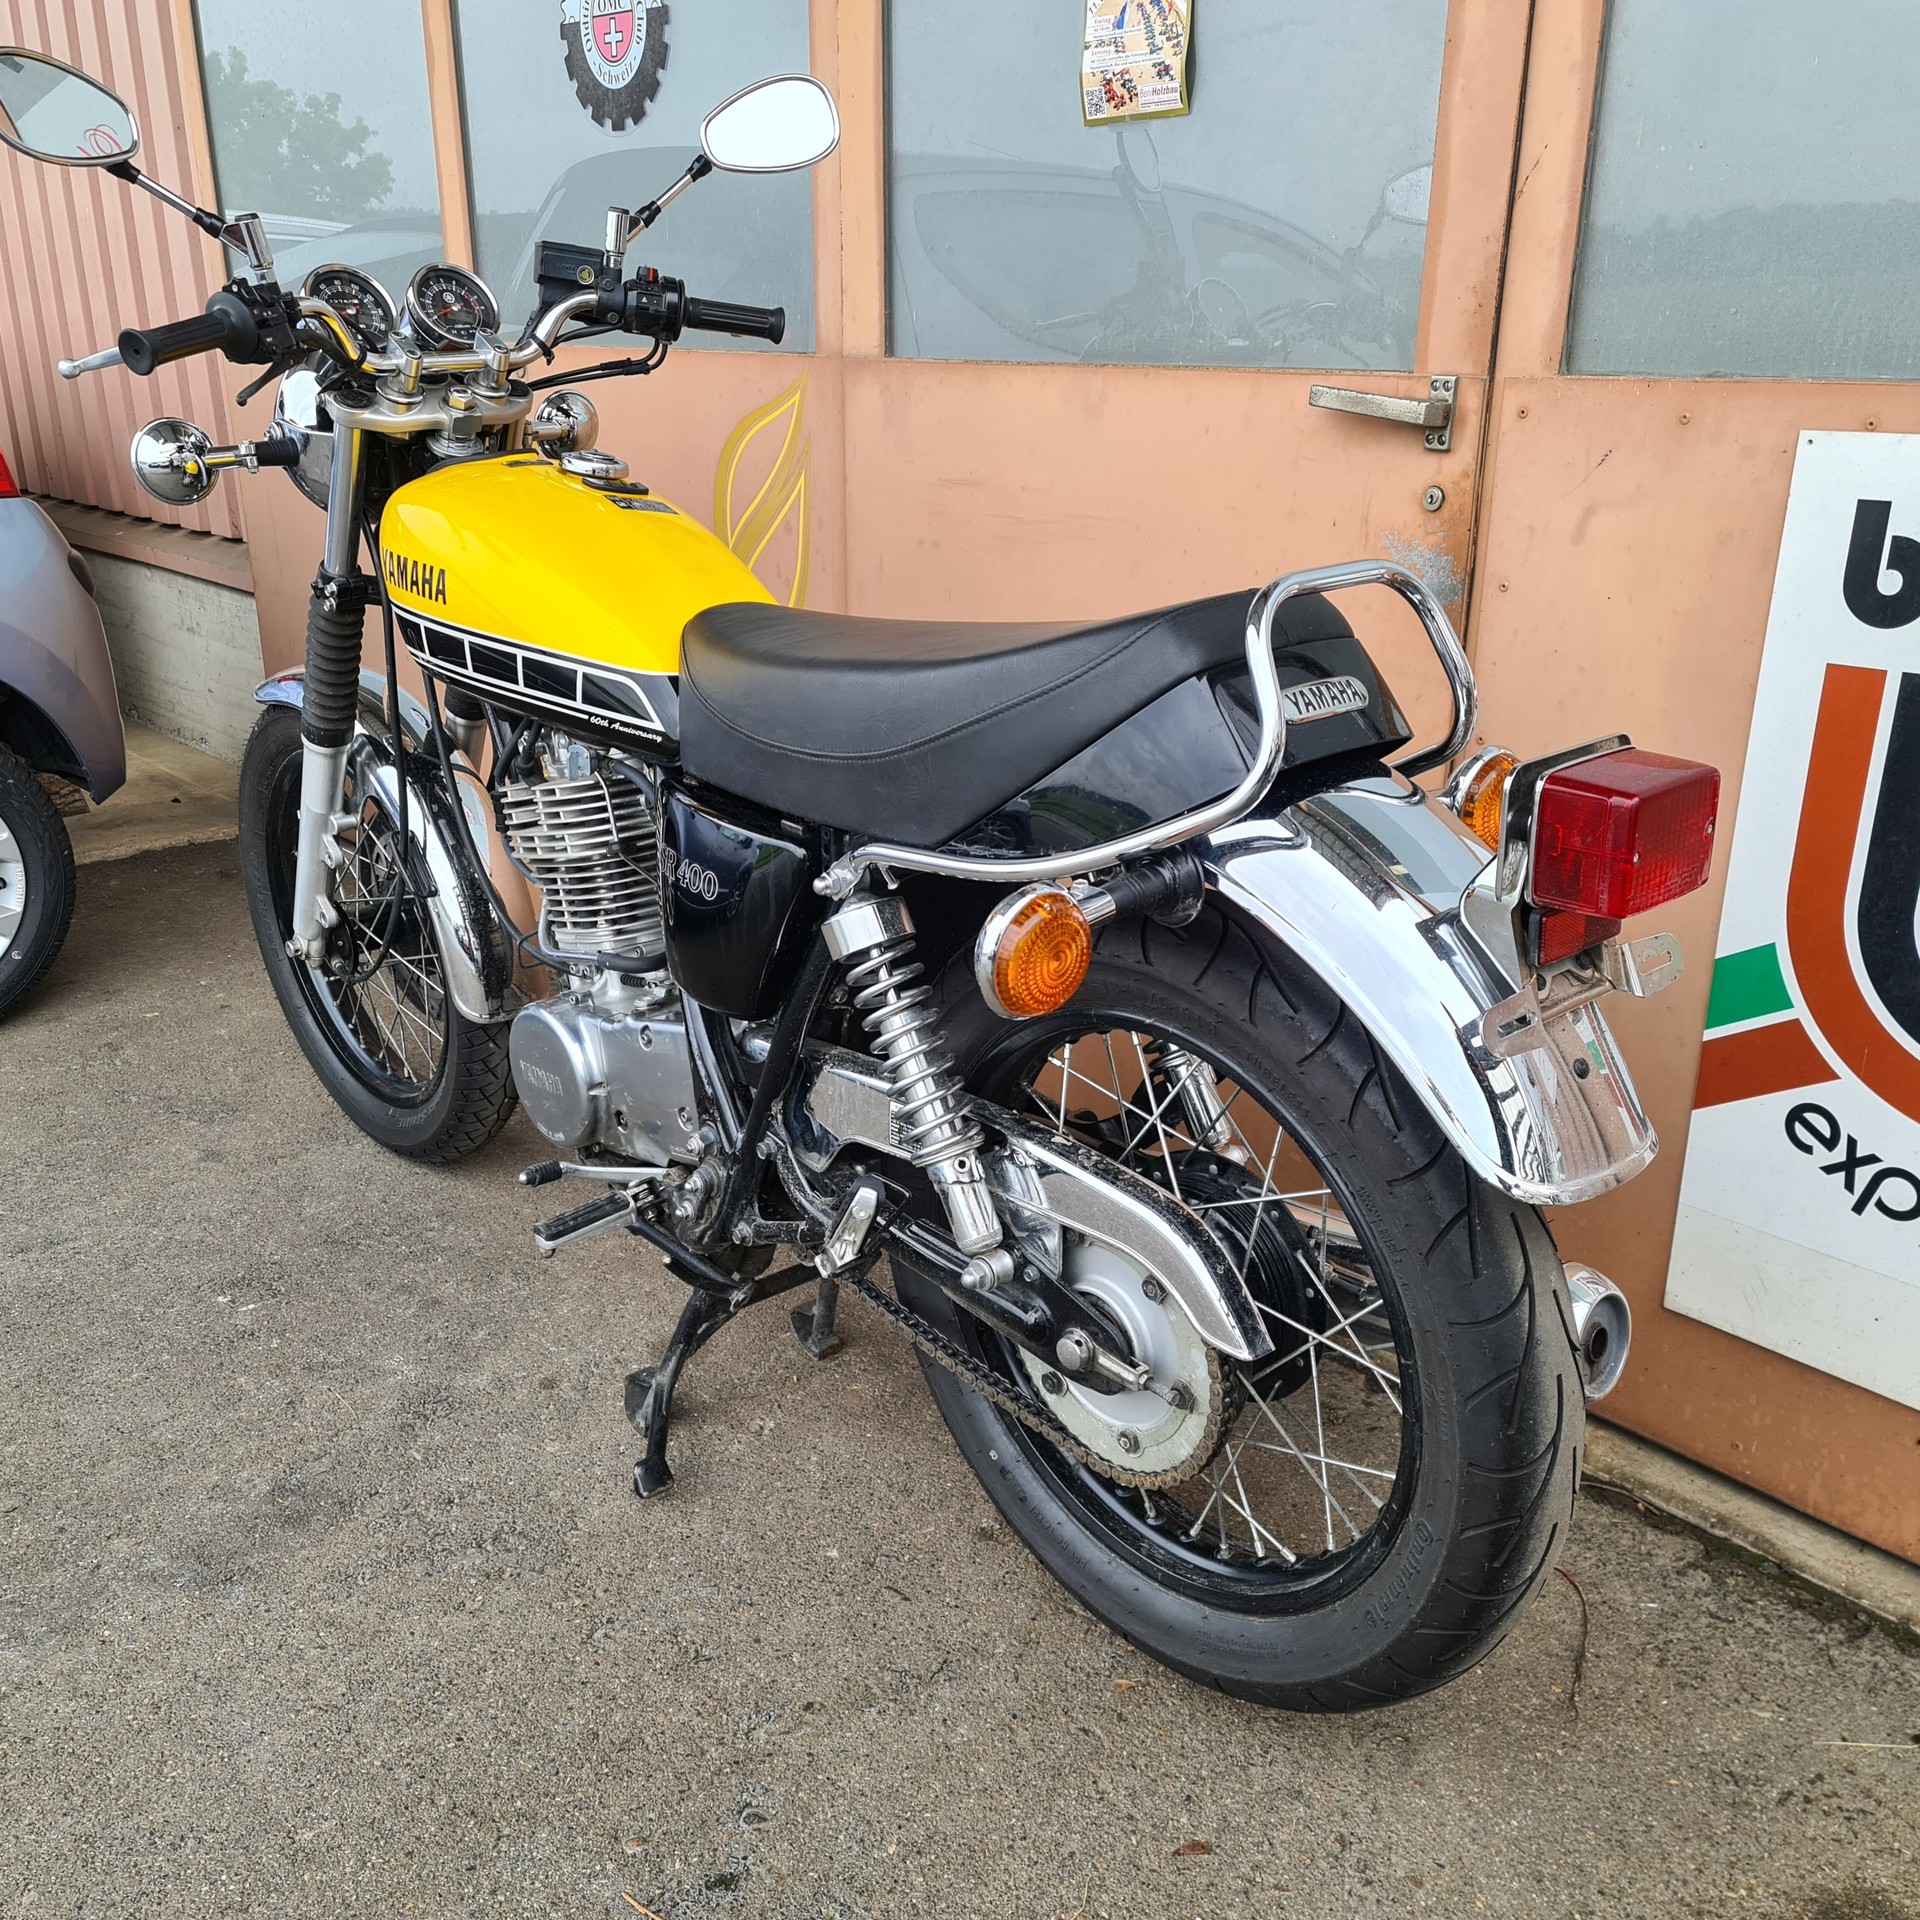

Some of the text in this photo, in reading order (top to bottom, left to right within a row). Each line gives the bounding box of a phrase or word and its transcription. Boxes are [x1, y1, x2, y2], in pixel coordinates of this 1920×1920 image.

[597, 0, 626, 13] OMC
[636, 2, 645, 45] Club
[597, 62, 635, 85] Schweiz
[1152, 84, 1179, 97] Holzbau
[382, 545, 447, 605] YAMAHA
[1284, 679, 1365, 715] YAMAHA
[590, 715, 663, 743] 60th Anniversary
[1784, 1102, 1920, 1222] exp
